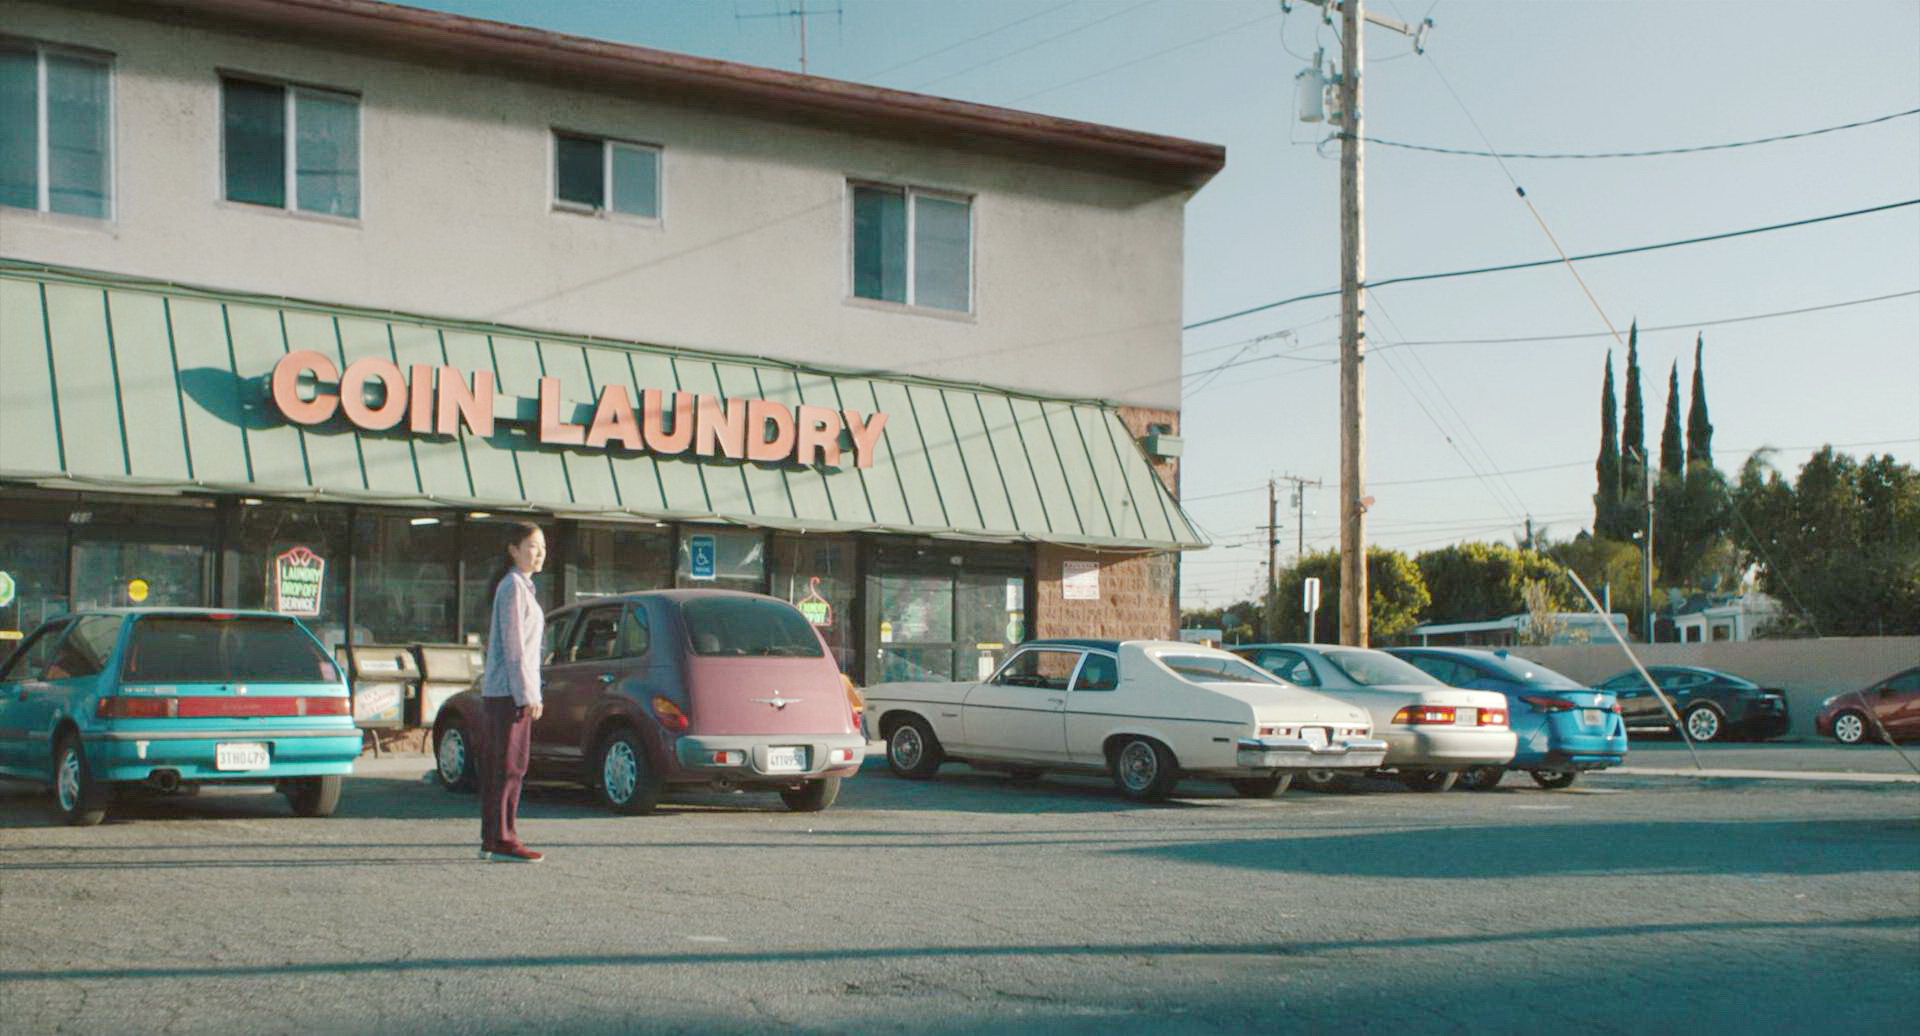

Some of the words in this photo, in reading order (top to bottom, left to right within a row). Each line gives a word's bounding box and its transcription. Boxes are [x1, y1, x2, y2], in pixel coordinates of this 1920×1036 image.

[272, 350, 494, 438] COIN
[539, 376, 889, 468] LAUNDRY
[282, 565, 320, 582] LAUNDRY
[281, 596, 315, 611] SERVICE
